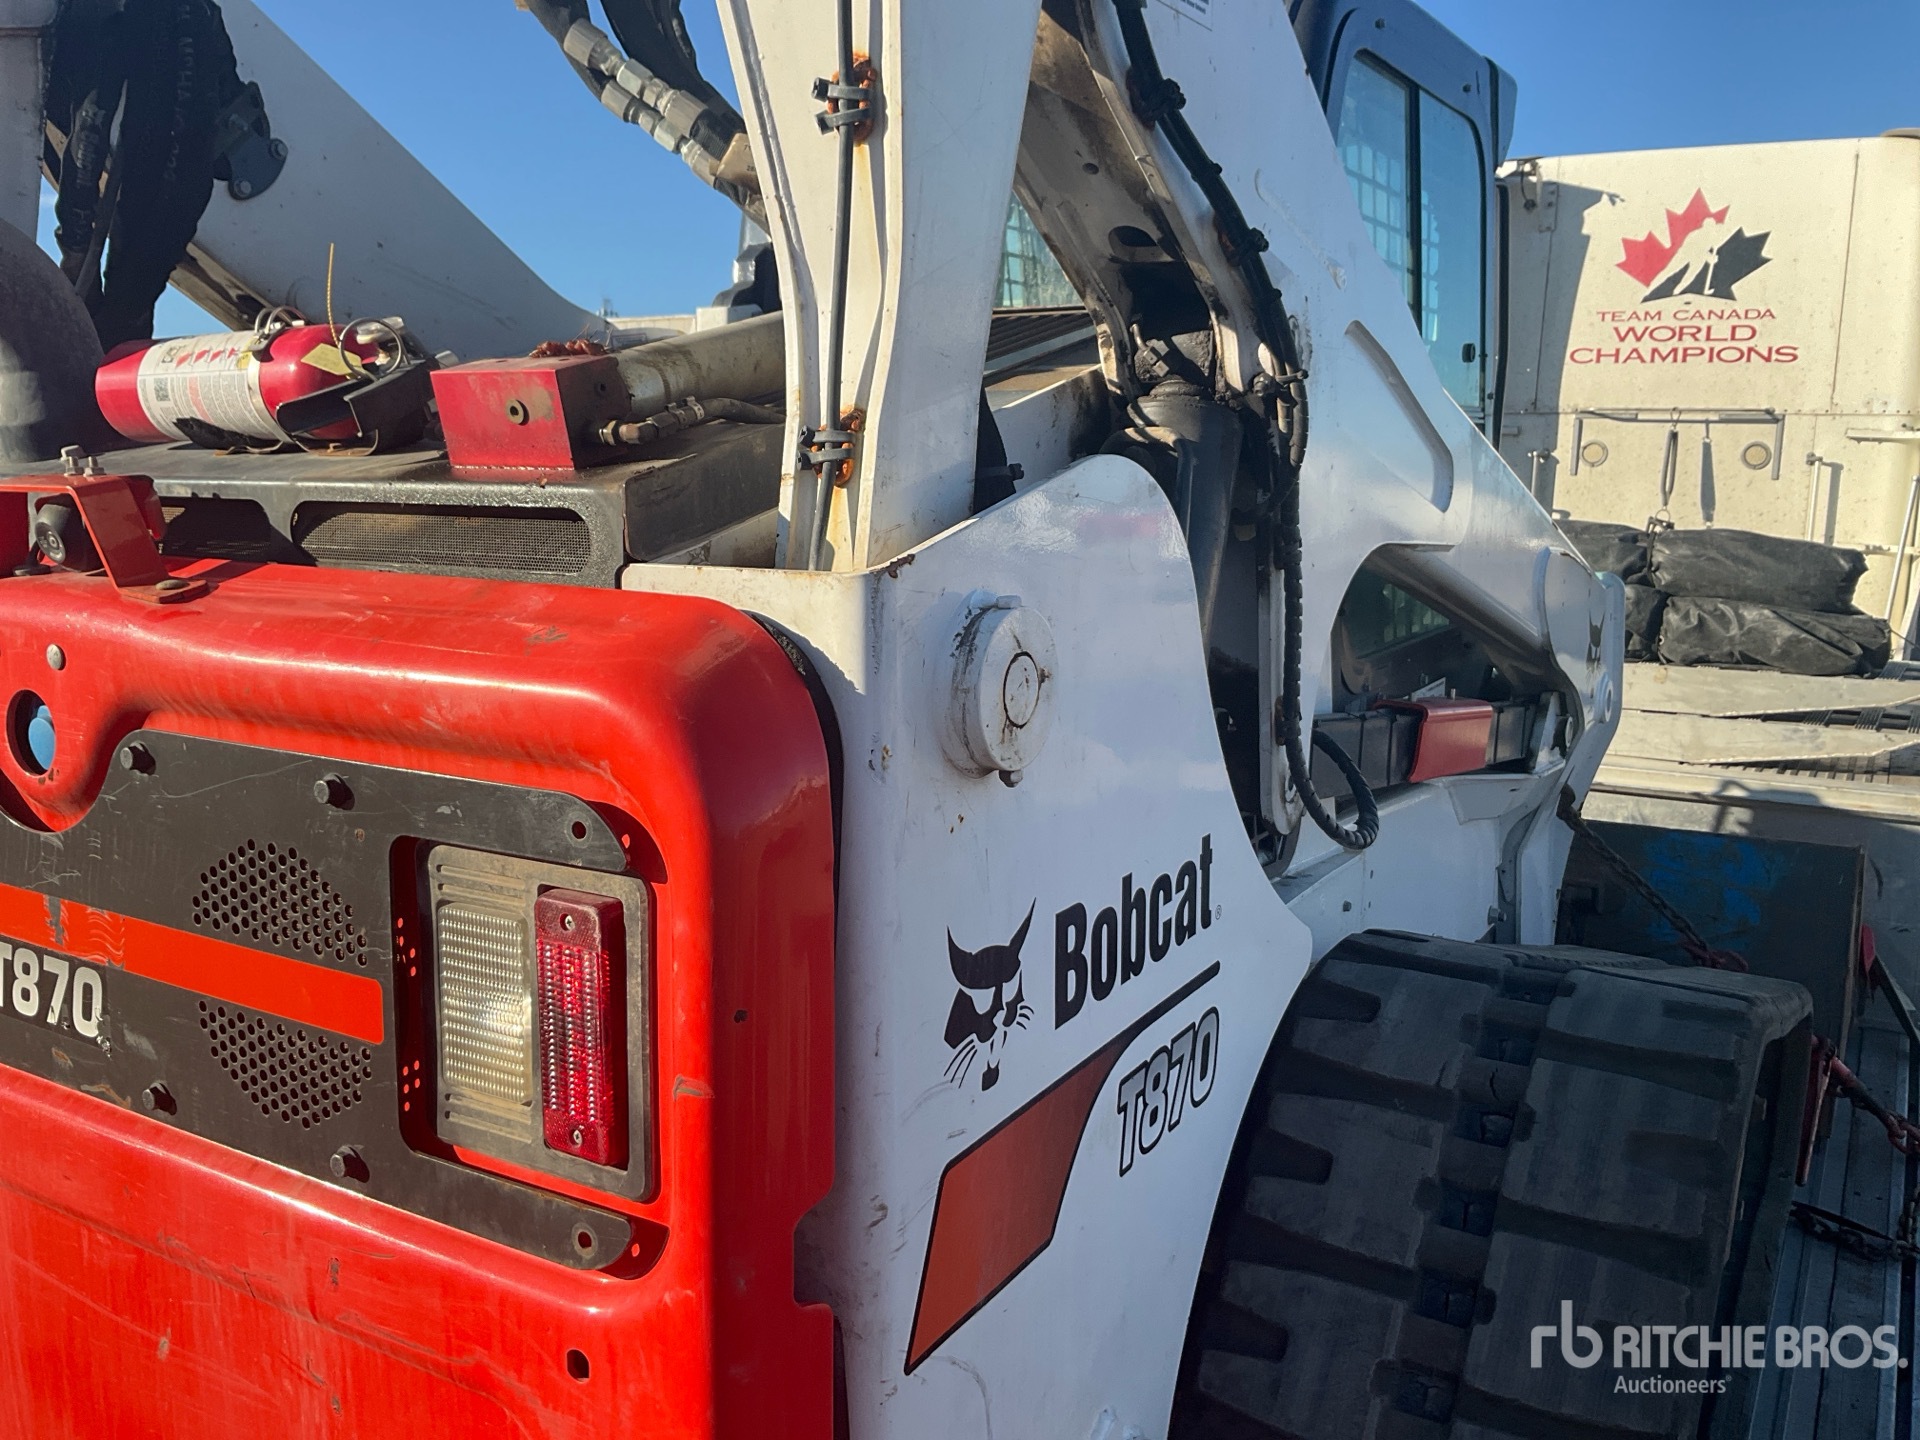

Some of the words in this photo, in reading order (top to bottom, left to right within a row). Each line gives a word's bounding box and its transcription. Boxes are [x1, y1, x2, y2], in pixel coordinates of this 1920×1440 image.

[1596, 309, 1663, 322] TEAM
[1672, 307, 1776, 321] CANADA
[1612, 324, 1758, 343] WORLD
[1568, 345, 1799, 365] CHAMPIONS
[1116, 1005, 1220, 1178] T870
